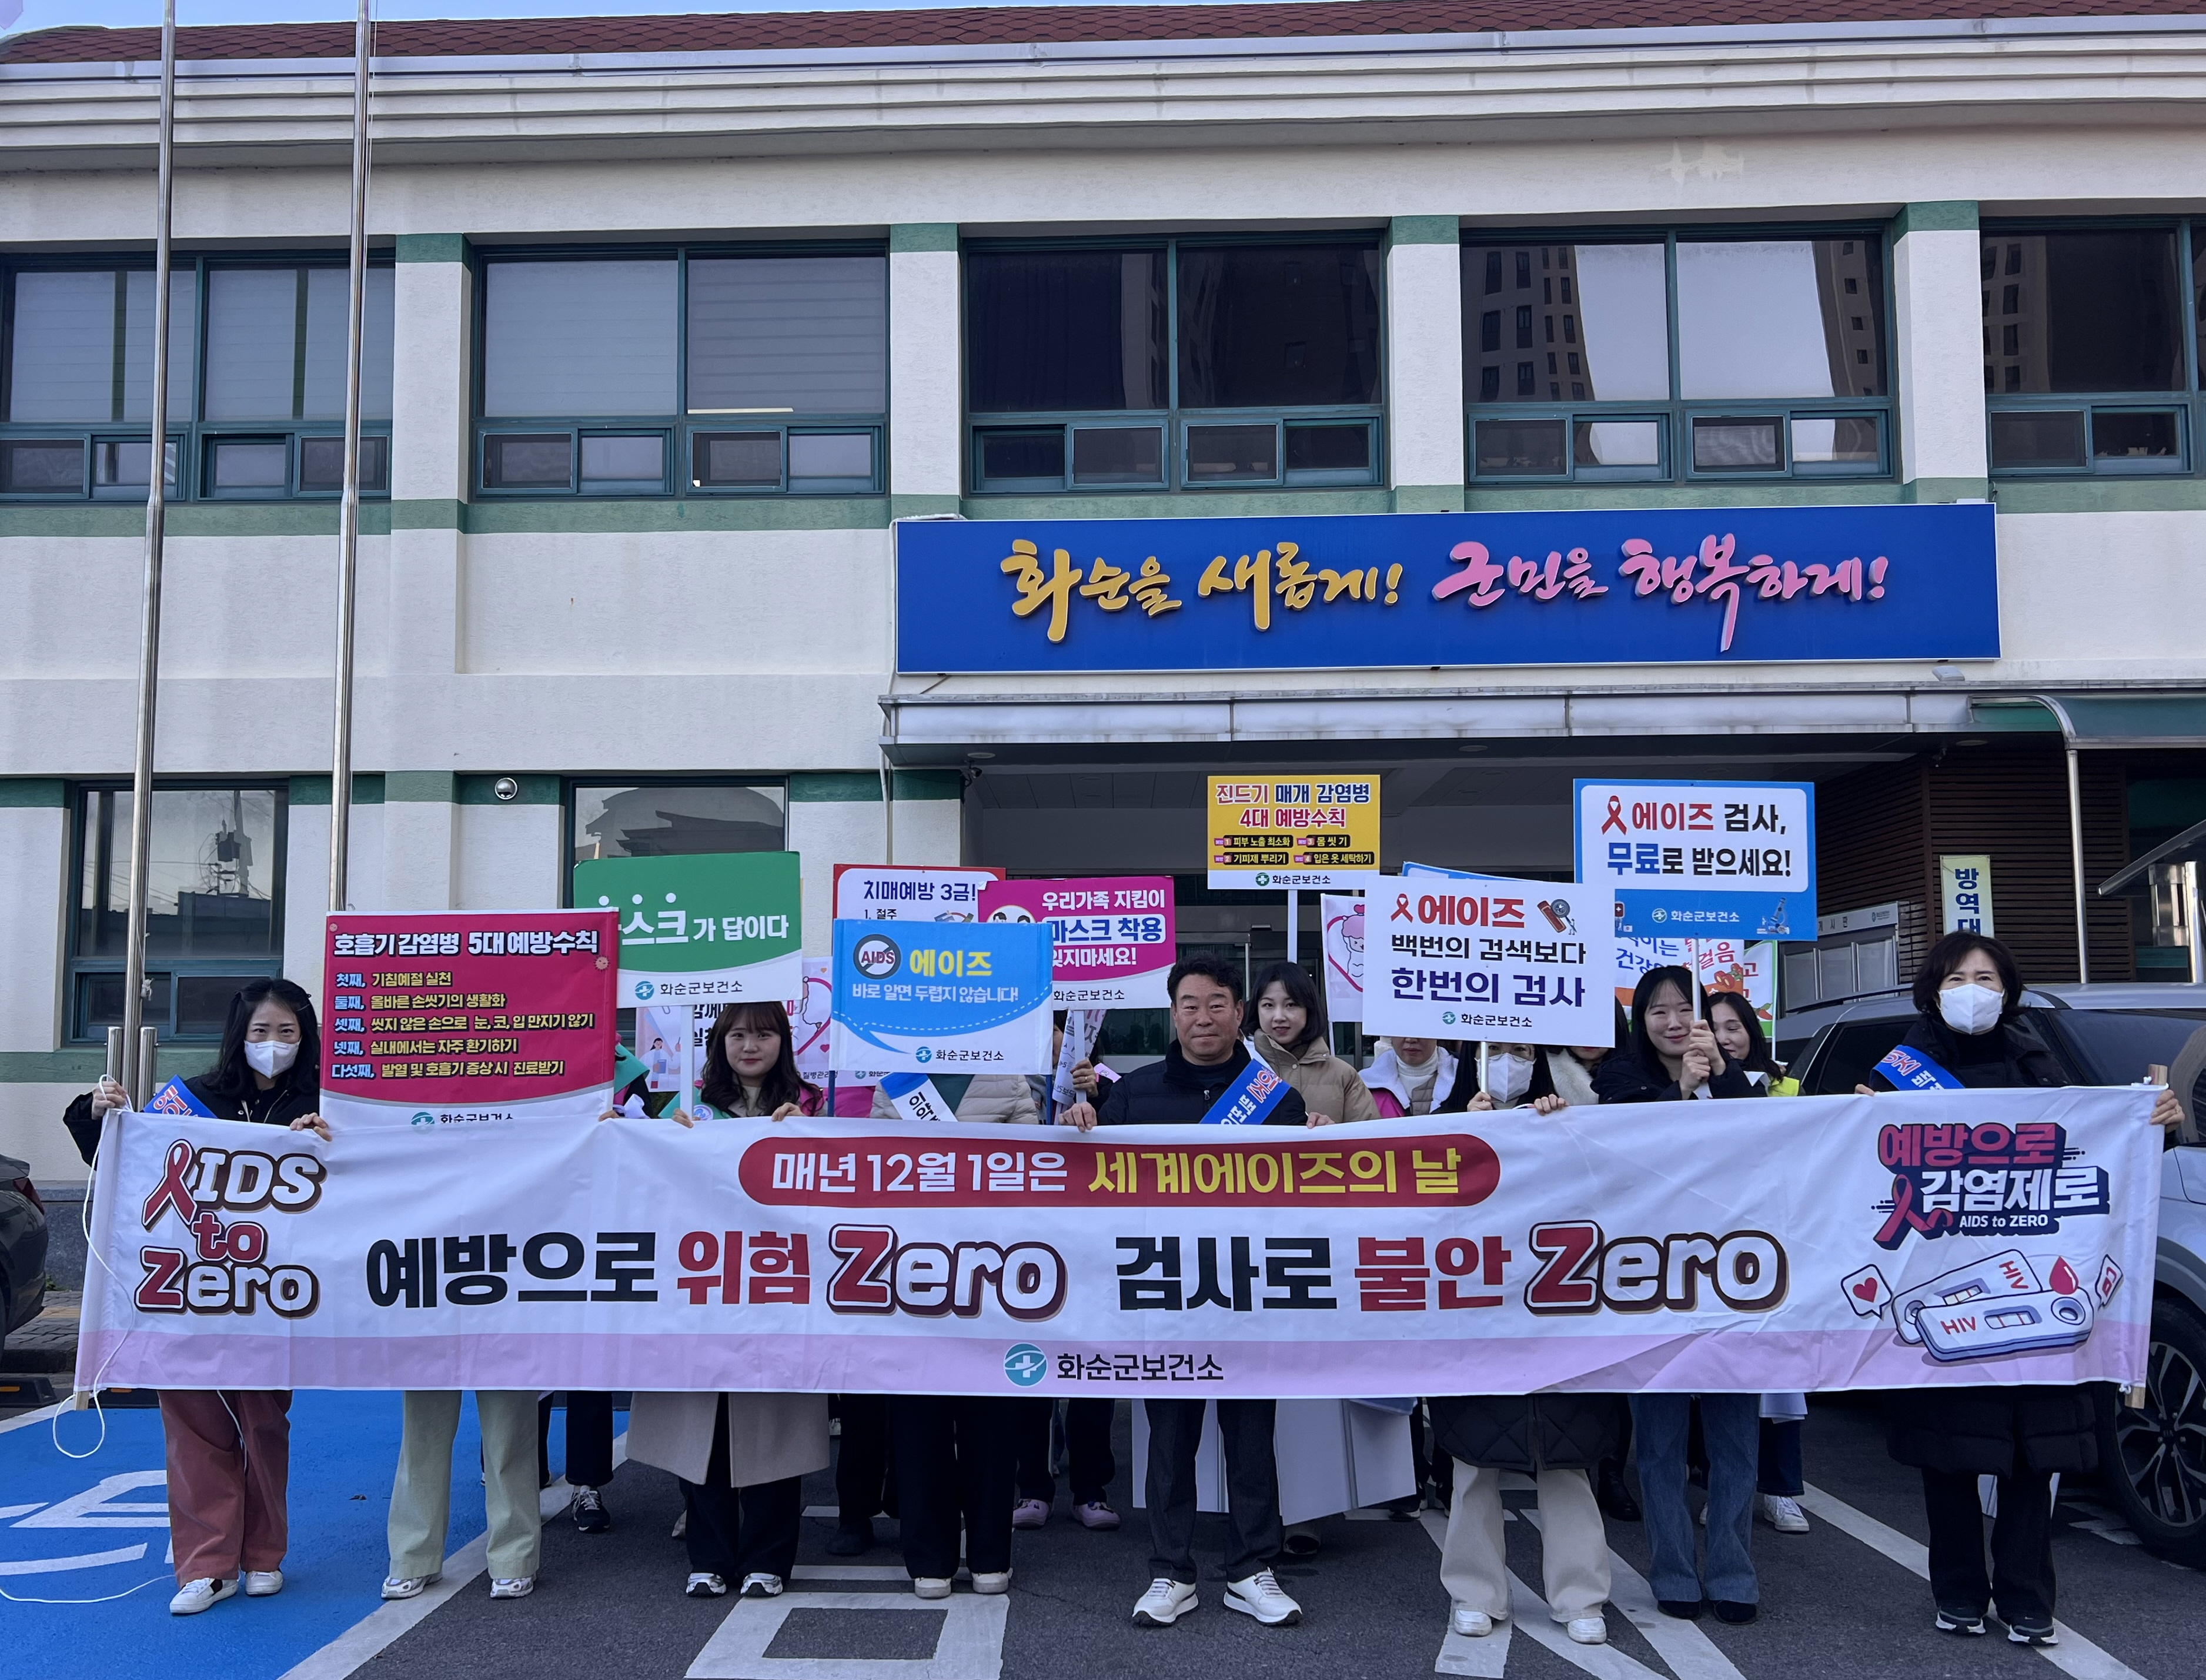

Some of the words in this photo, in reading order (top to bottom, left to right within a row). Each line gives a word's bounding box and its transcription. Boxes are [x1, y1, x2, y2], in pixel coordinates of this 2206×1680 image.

[1000, 539, 1182, 643] 화순을
[1198, 542, 1403, 632] 새롭게!
[1432, 541, 1609, 608] 군민을
[1619, 533, 1889, 652] 행복하게!
[1216, 784, 1269, 804] 진드기
[1275, 784, 1310, 804] 매개
[1316, 783, 1369, 804] 감염병
[1239, 809, 1269, 828] 4대
[1275, 808, 1346, 828] 예방수칙
[1632, 802, 1714, 831] 에이즈
[1724, 804, 1786, 834] 검사,
[1234, 837, 1248, 847] 피부
[1234, 854, 1258, 863] 기피제
[1314, 854, 1329, 863] 입은
[1608, 843, 1684, 875] 무료로
[1693, 847, 1791, 877] 받으세요!
[1272, 875, 1331, 884] 화순군보건소
[864, 880, 935, 900] 치매예방
[941, 884, 976, 901] 3금!
[1042, 890, 1110, 910] 우리가족
[1114, 890, 1165, 909] 지킴이
[1418, 895, 1525, 928] 에이즈
[1671, 910, 1740, 923] 화순군보건소
[722, 915, 789, 941] 답이다
[1118, 917, 1162, 941] 착용
[334, 933, 396, 956] 호흡기
[397, 932, 460, 955] 감염병
[468, 931, 505, 954] 5대
[507, 930, 597, 954] 예방수칙
[1391, 934, 1469, 959] 백번의
[1479, 938, 1586, 964] 검색보다
[861, 951, 895, 964] AIDS
[910, 948, 992, 977] 에이즈
[336, 973, 366, 987] 첫째,
[372, 973, 423, 987] 기침예절
[426, 972, 452, 986] 실천
[660, 981, 743, 996] 화순군보건소
[1391, 967, 1499, 1003] 한번의
[1513, 974, 1586, 1007] 검사
[335, 996, 365, 1010] 둘째,
[371, 995, 410, 1010] 올바른
[412, 994, 463, 1008] 손씻기의
[466, 993, 506, 1007] 생활화
[853, 983, 881, 999] 바로
[884, 984, 911, 1001] 알면
[915, 986, 957, 1003] 두렵지
[959, 987, 1018, 1003] 않습니다!
[1054, 990, 1125, 1001] 화순군보건소
[335, 1018, 365, 1032] 셋째,
[371, 1017, 397, 1031] 씻지
[400, 1017, 426, 1031] 않은
[428, 1016, 467, 1030] 손으로
[474, 1016, 492, 1030] 눈,
[493, 1016, 510, 1029] 코,
[513, 1015, 525, 1028] 입
[528, 1014, 566, 1028] 만지기
[568, 1013, 593, 1027] 않기
[1460, 1013, 1533, 1027] 화순군보건소
[333, 1041, 364, 1056] 넷째,
[370, 1040, 436, 1055] 실내에서는
[438, 1039, 464, 1054] 자주
[466, 1038, 517, 1053] 환기하기
[935, 1048, 1004, 1061] 화순군보건소
[331, 1063, 375, 1078] 다섯째,
[382, 1063, 408, 1077] 발열
[410, 1063, 423, 1076] 및
[426, 1062, 464, 1076] 호흡기
[466, 1061, 493, 1076] 증상
[494, 1061, 507, 1074] 시
[513, 1061, 564, 1076] 진료받기
[1881, 1123, 2057, 1167] 예방으로
[772, 1152, 857, 1193] 매년
[867, 1151, 957, 1193] 12월
[968, 1150, 1068, 1193] 1일은
[1088, 1149, 1397, 1195] 세계에이즈의
[1412, 1148, 1462, 1195] 날
[1920, 1165, 2100, 1213] 감염제로
[1959, 1215, 1988, 1228] AIDS
[1991, 1215, 2006, 1228] to
[2009, 1214, 2048, 1227] ZERO
[191, 1211, 268, 1262] to
[366, 1231, 659, 1308] 예방으로
[677, 1230, 811, 1306] 위험
[826, 1224, 1066, 1321] Zero
[1115, 1236, 1338, 1312] 검사로
[1353, 1235, 1512, 1312] 불안
[1523, 1220, 1789, 1317] Zero
[1998, 1260, 2029, 1289] HIV
[135, 1245, 320, 1318] Zero
[1940, 1317, 1976, 1335] HIV
[1057, 1353, 1224, 1382] 화순군보건소
